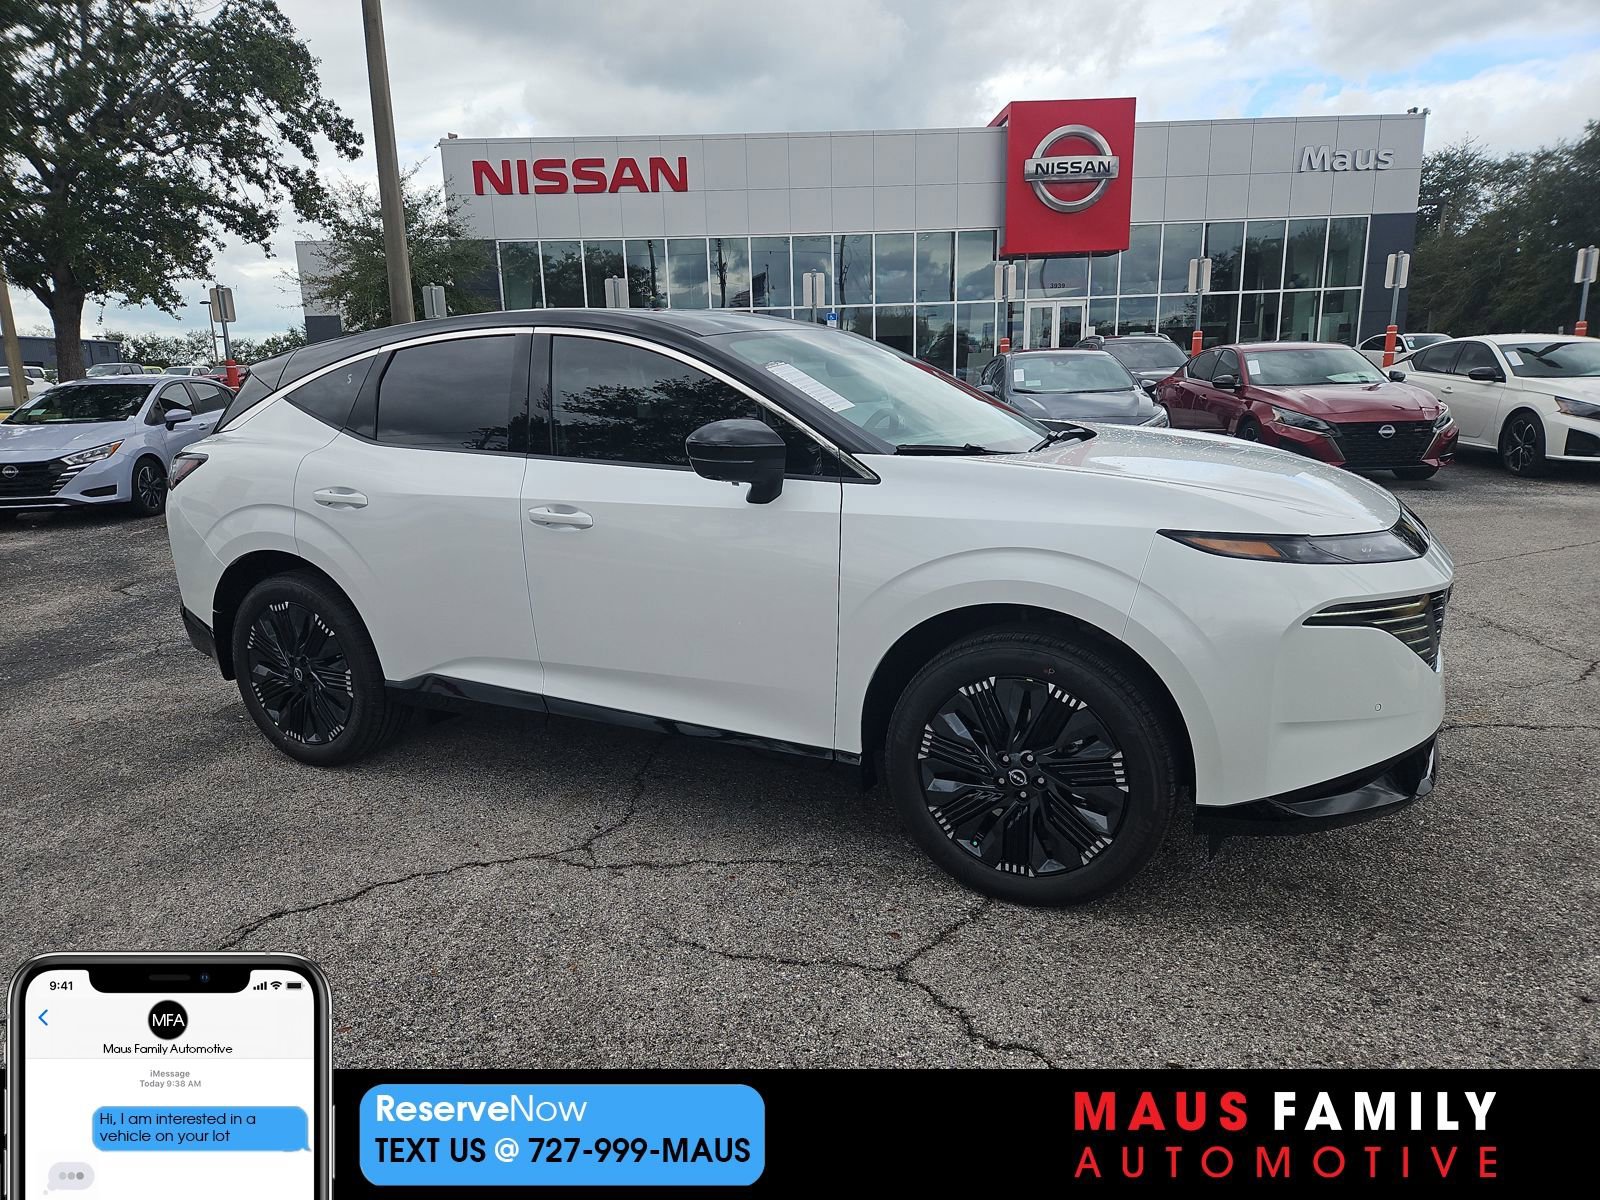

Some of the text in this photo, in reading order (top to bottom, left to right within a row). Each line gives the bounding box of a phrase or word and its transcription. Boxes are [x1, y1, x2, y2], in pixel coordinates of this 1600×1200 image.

[1035, 161, 1111, 175] NISSAN
[1300, 145, 1395, 171] Maus
[473, 157, 688, 194] NISSAN
